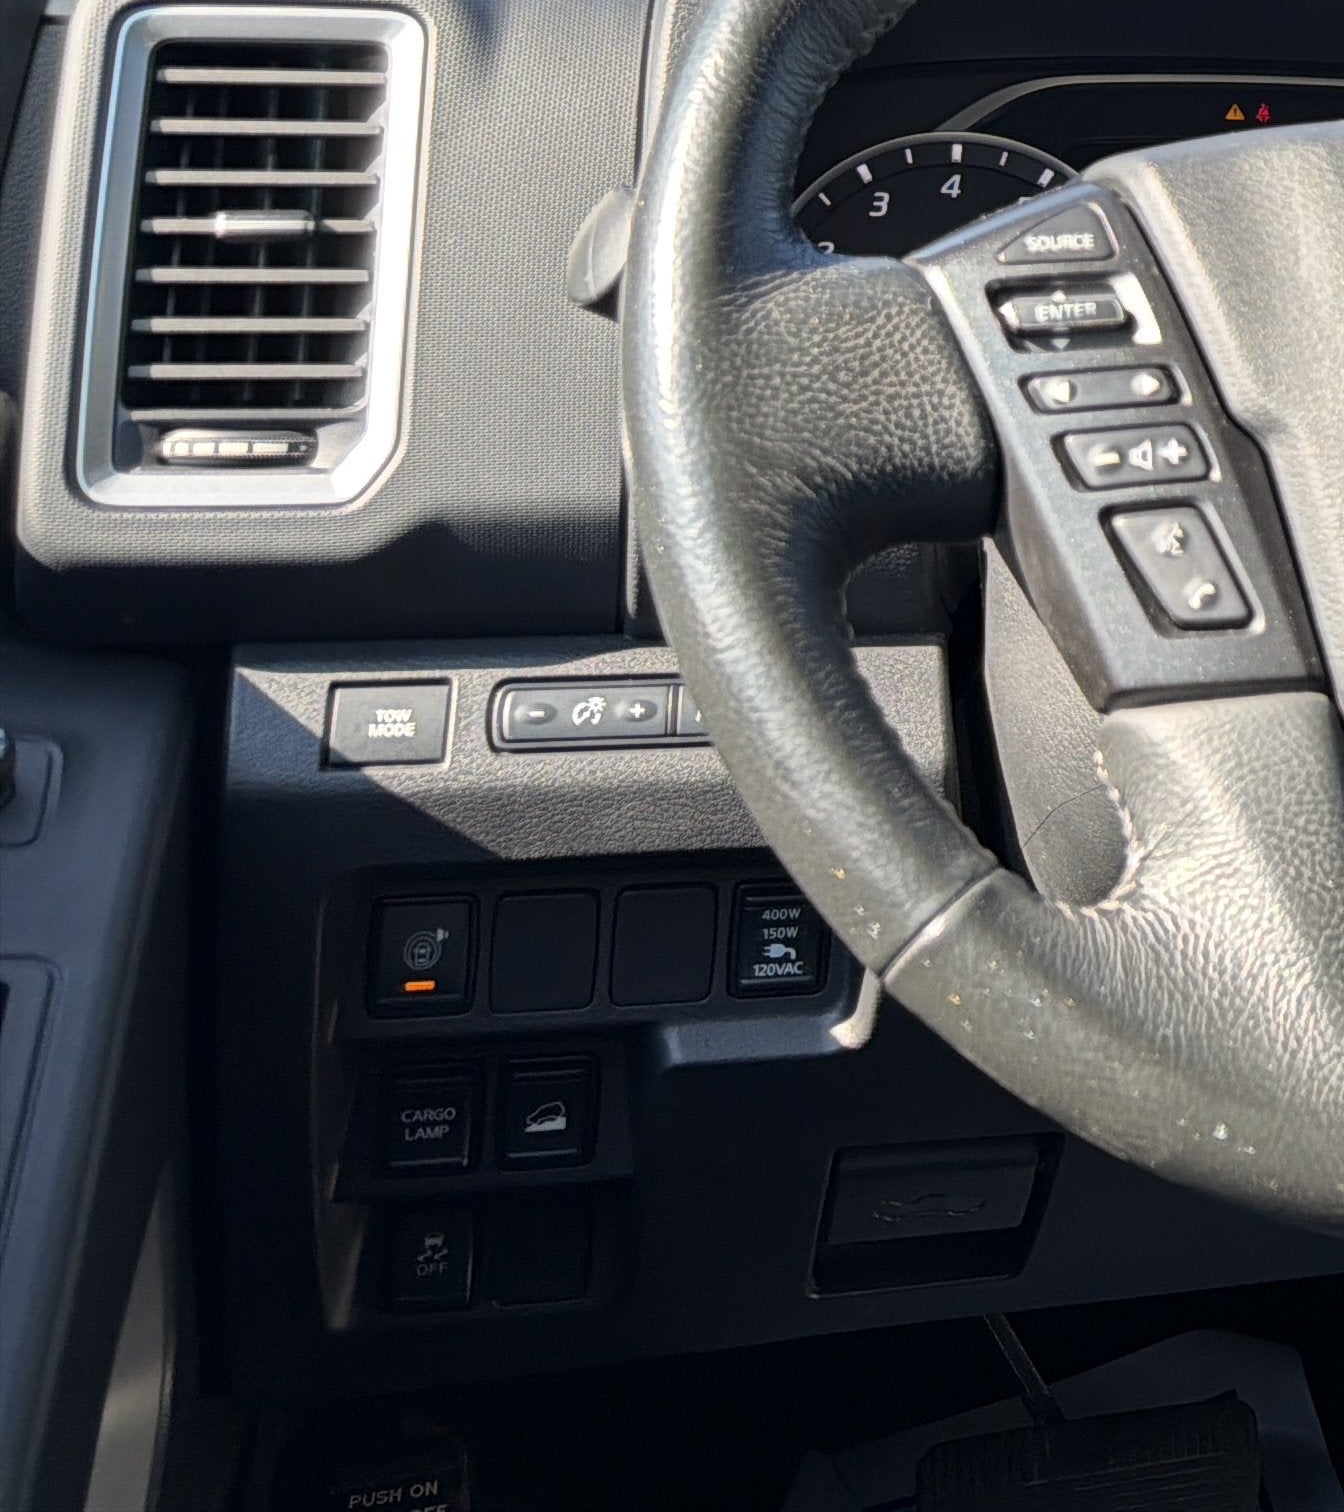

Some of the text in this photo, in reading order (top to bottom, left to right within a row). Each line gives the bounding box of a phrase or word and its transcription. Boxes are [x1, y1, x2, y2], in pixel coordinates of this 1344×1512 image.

[941, 174, 962, 199] 4
[868, 191, 890, 217] 3
[1024, 233, 1094, 251] SOURCE
[1035, 302, 1097, 322] ENTER
[375, 709, 412, 722] TOW
[762, 908, 801, 921] 400W
[762, 926, 799, 940] 150W
[753, 961, 804, 977] 120VAC
[401, 1107, 456, 1124] CARGO
[404, 1125, 449, 1141] LAMP
[416, 1262, 448, 1276] OFF
[348, 1489, 401, 1509] PUSH
[410, 1480, 439, 1498] ON
